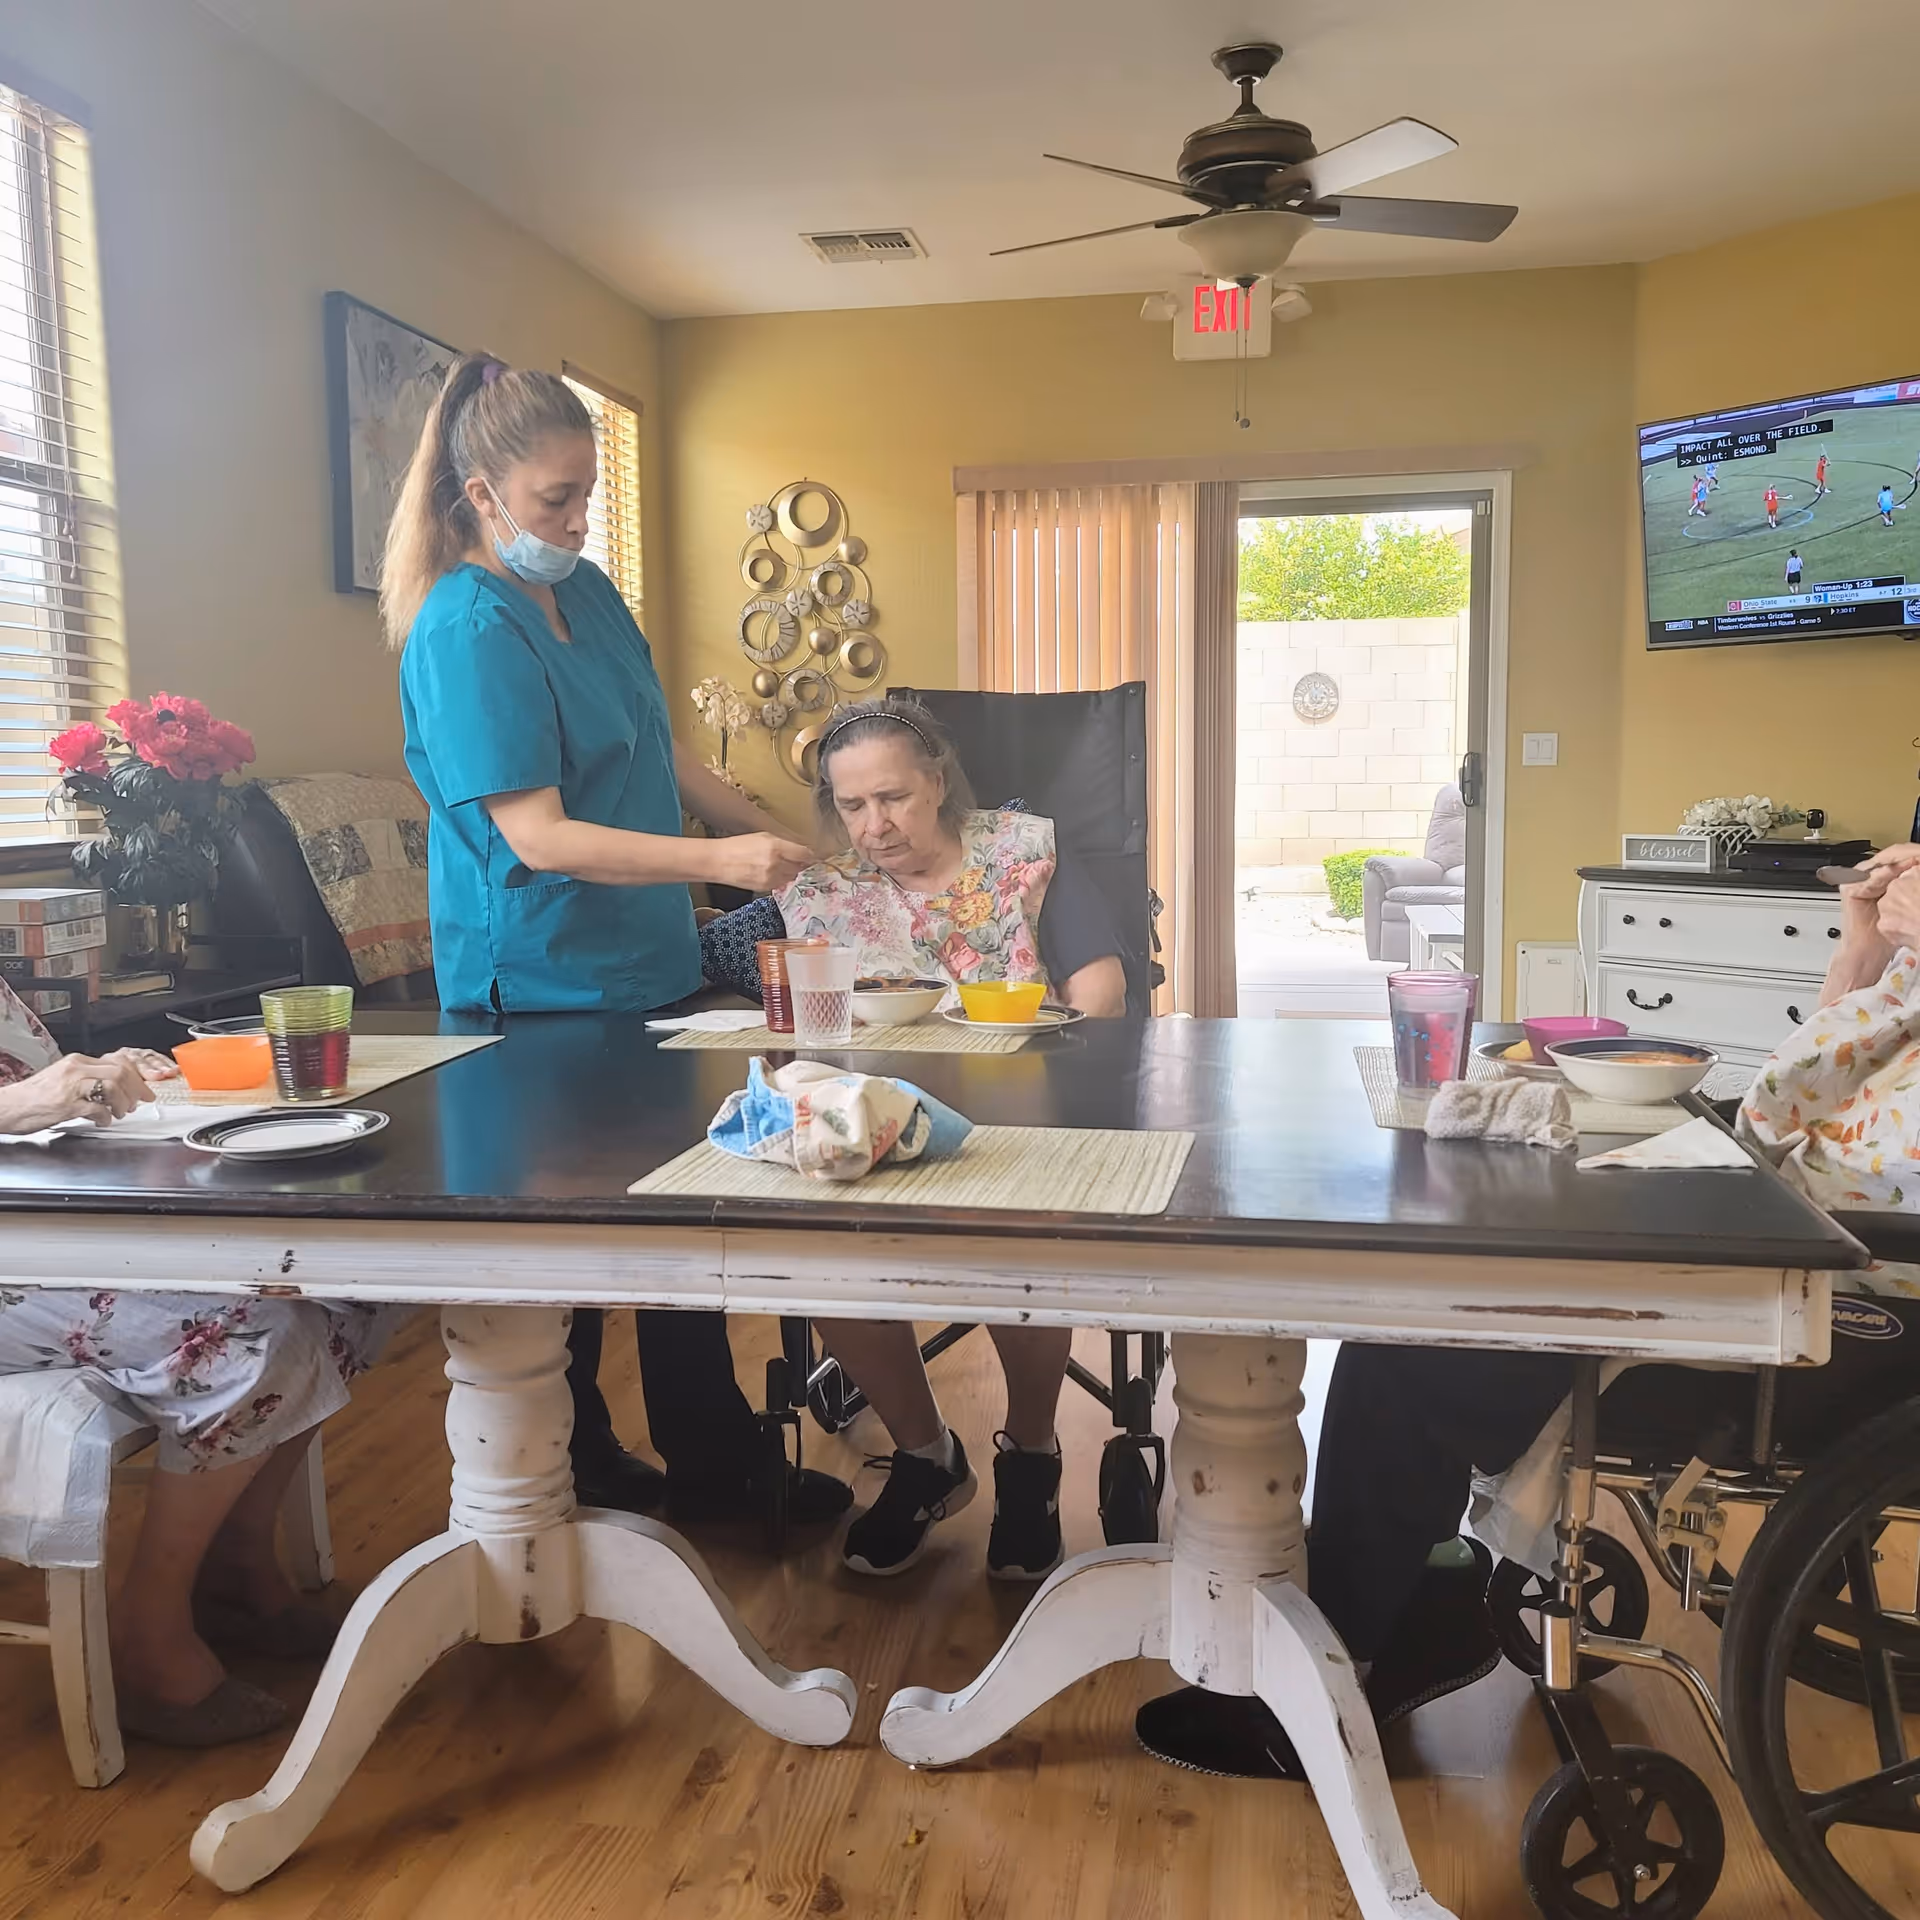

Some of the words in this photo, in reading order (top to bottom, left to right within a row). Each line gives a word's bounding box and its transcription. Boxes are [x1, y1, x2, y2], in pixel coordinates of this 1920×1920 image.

[1193, 283, 1257, 333] EXIT
[1680, 441, 1712, 454] IMPACT
[1717, 437, 1733, 448] ALL
[1738, 434, 1761, 445] OVER
[1766, 429, 1783, 440] THE
[1788, 424, 1822, 437] FIELD.
[1696, 452, 1728, 464] Quint:
[1733, 445, 1772, 458] ESMOND.
[1815, 583, 1852, 592] Woman-Up
[1855, 580, 1873, 589] 1:23
[1805, 595, 1811, 603] 9
[1830, 592, 1859, 600] Hopkins
[1891, 588, 1903, 596] 12
[1717, 615, 1757, 623] Timberwolves
[1767, 612, 1794, 620] Grizzlies
[1640, 842, 1702, 859] blessed
